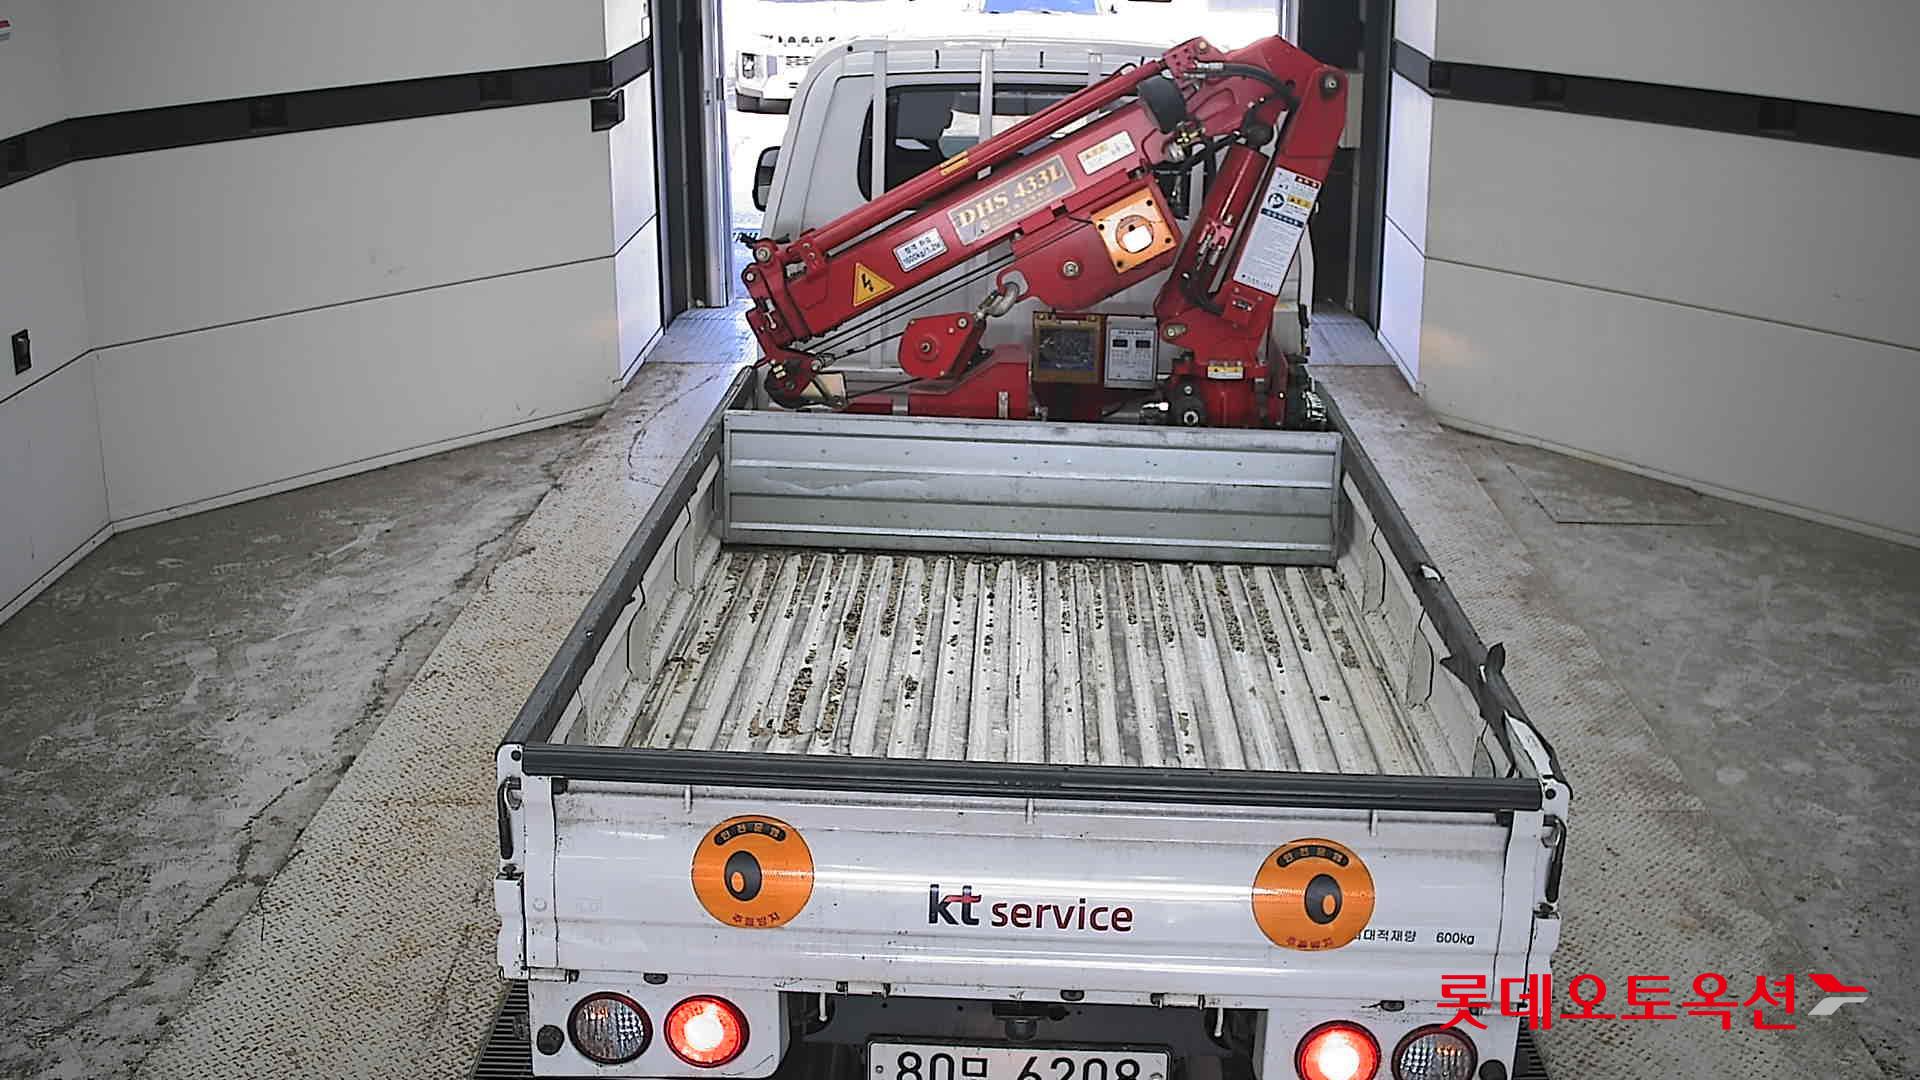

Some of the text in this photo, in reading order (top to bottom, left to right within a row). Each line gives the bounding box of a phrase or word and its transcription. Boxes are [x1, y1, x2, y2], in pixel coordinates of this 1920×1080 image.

[960, 192, 1008, 226] DHS
[1014, 165, 1065, 198] 433L
[928, 884, 1133, 932] kt service
[1357, 928, 1475, 945] 대적재량 600kg
